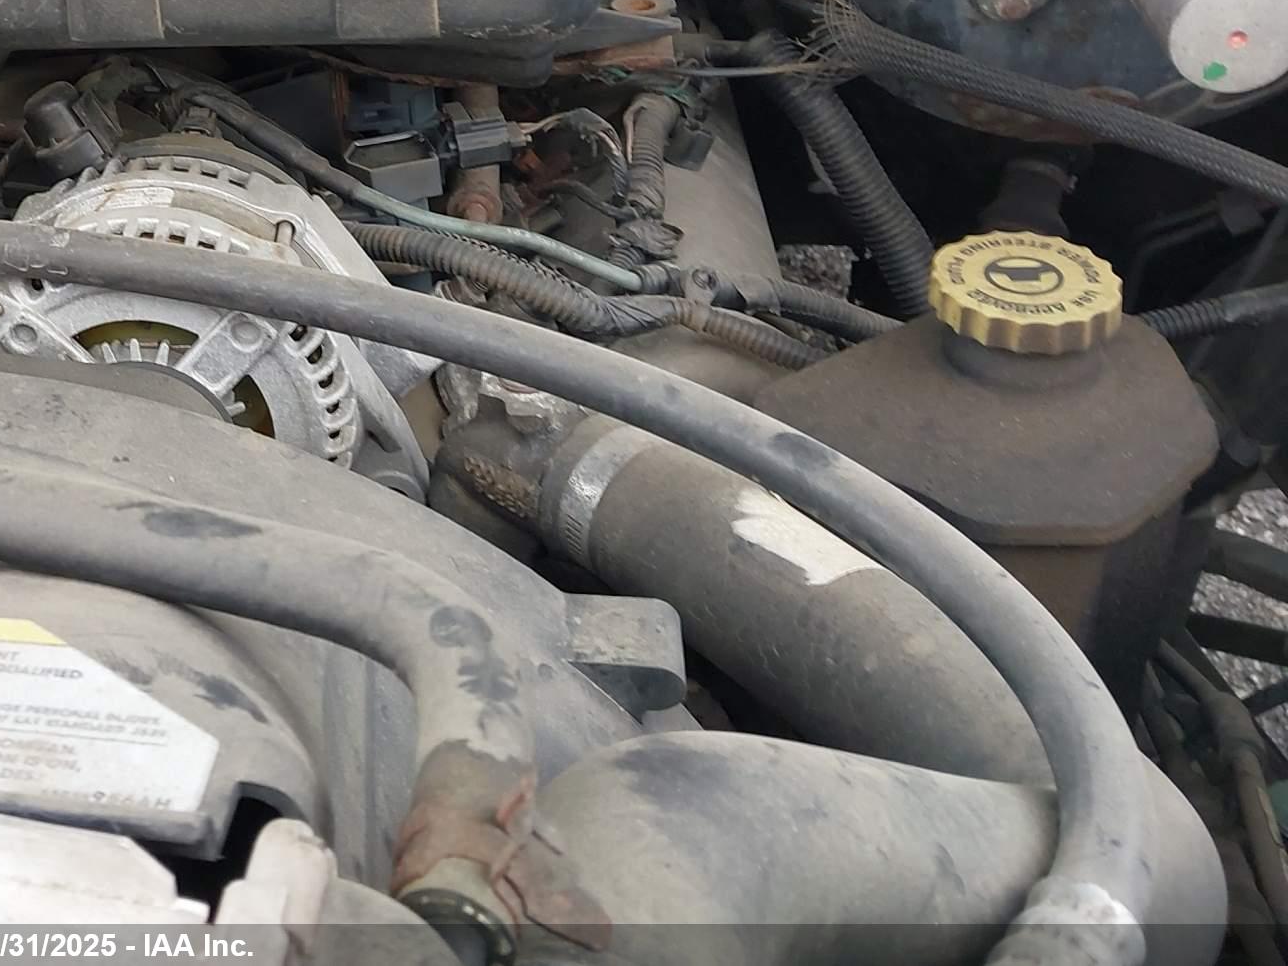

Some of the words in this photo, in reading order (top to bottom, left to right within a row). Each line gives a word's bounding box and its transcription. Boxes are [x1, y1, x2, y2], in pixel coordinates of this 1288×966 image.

[960, 237, 1053, 257] STEERING
[966, 288, 1068, 315] APPROVED
[1070, 289, 1100, 308] USE
